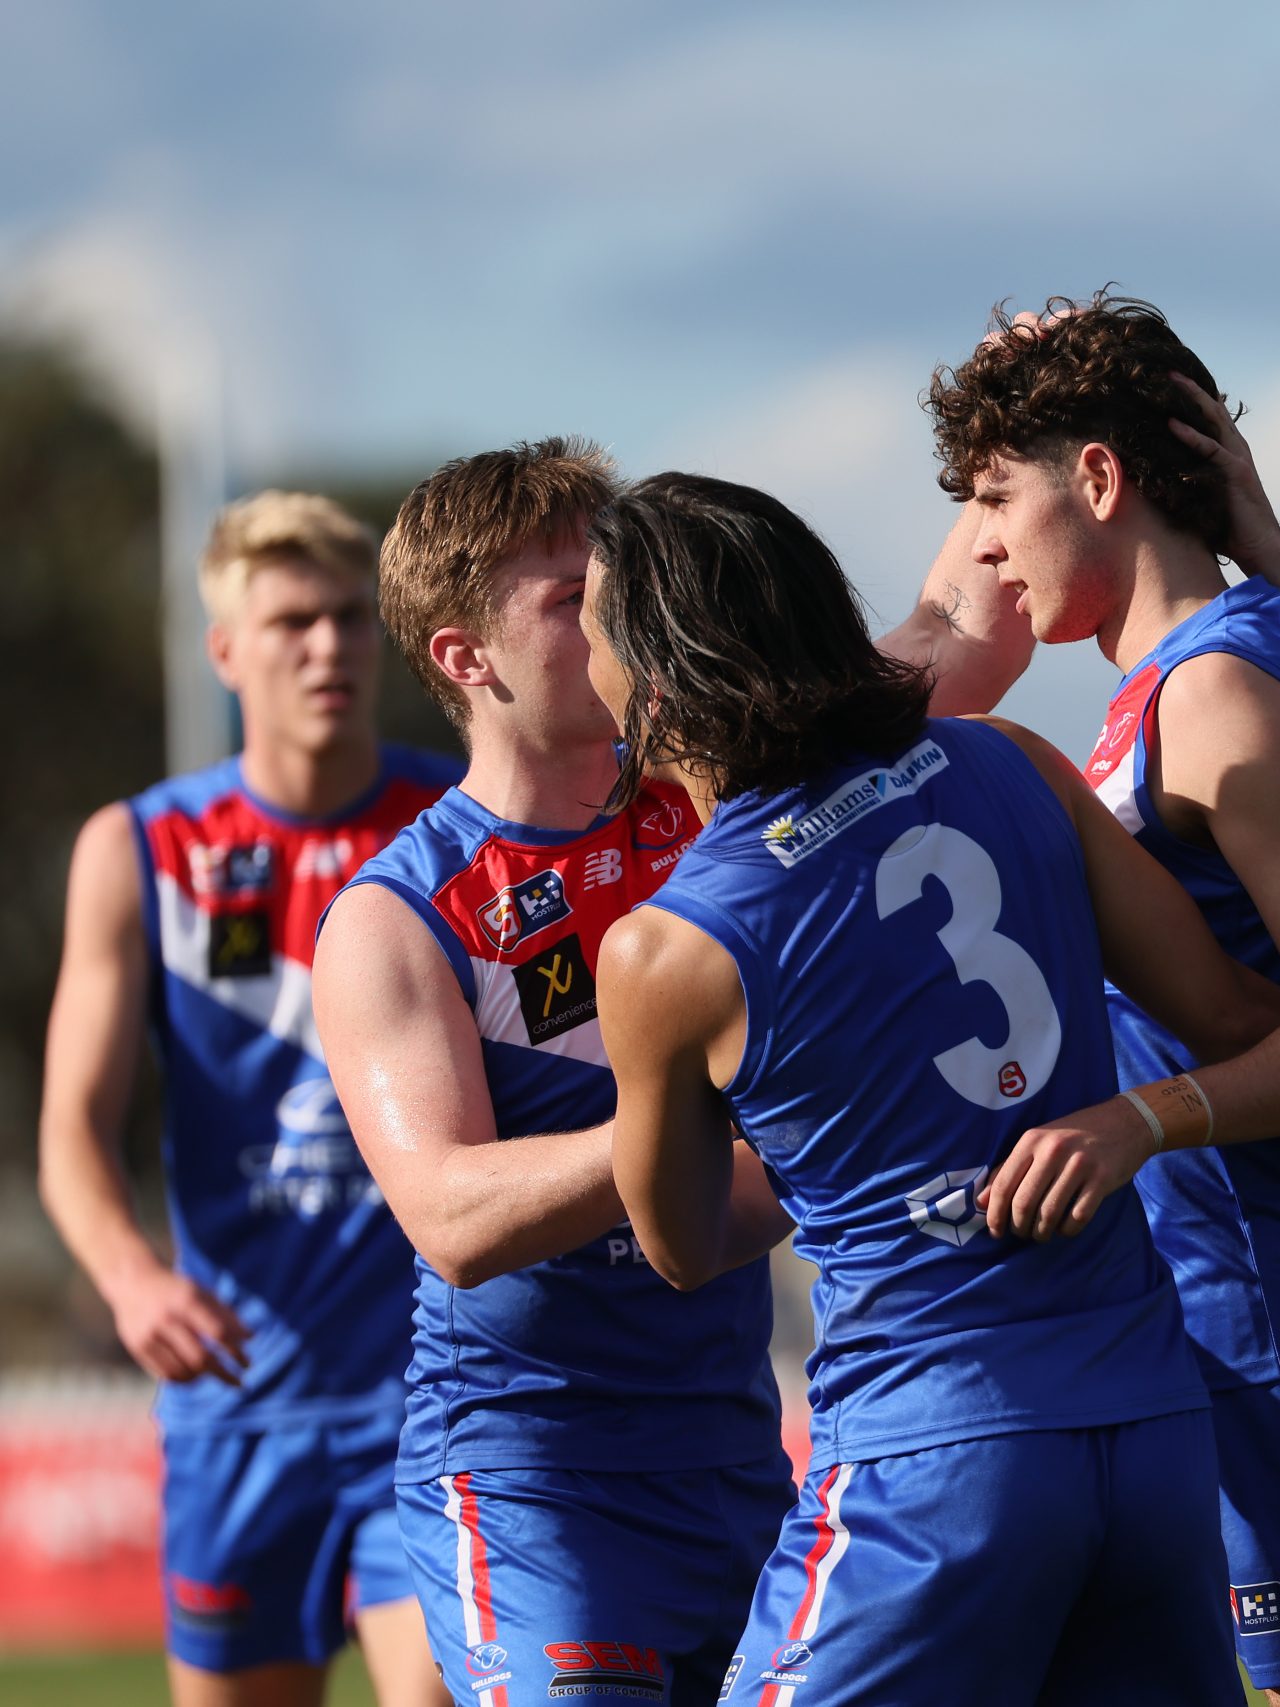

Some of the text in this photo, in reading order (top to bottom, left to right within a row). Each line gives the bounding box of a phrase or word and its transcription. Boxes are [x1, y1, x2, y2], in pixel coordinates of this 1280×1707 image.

[774, 784, 877, 853] Williams
[650, 838, 697, 873] BULLD
[875, 822, 1062, 1111] 3
[1244, 1615, 1279, 1626] HOSTPLUS
[543, 1641, 664, 1679] SEM
[549, 1686, 592, 1698] GROUP
[596, 1685, 612, 1696] OF
